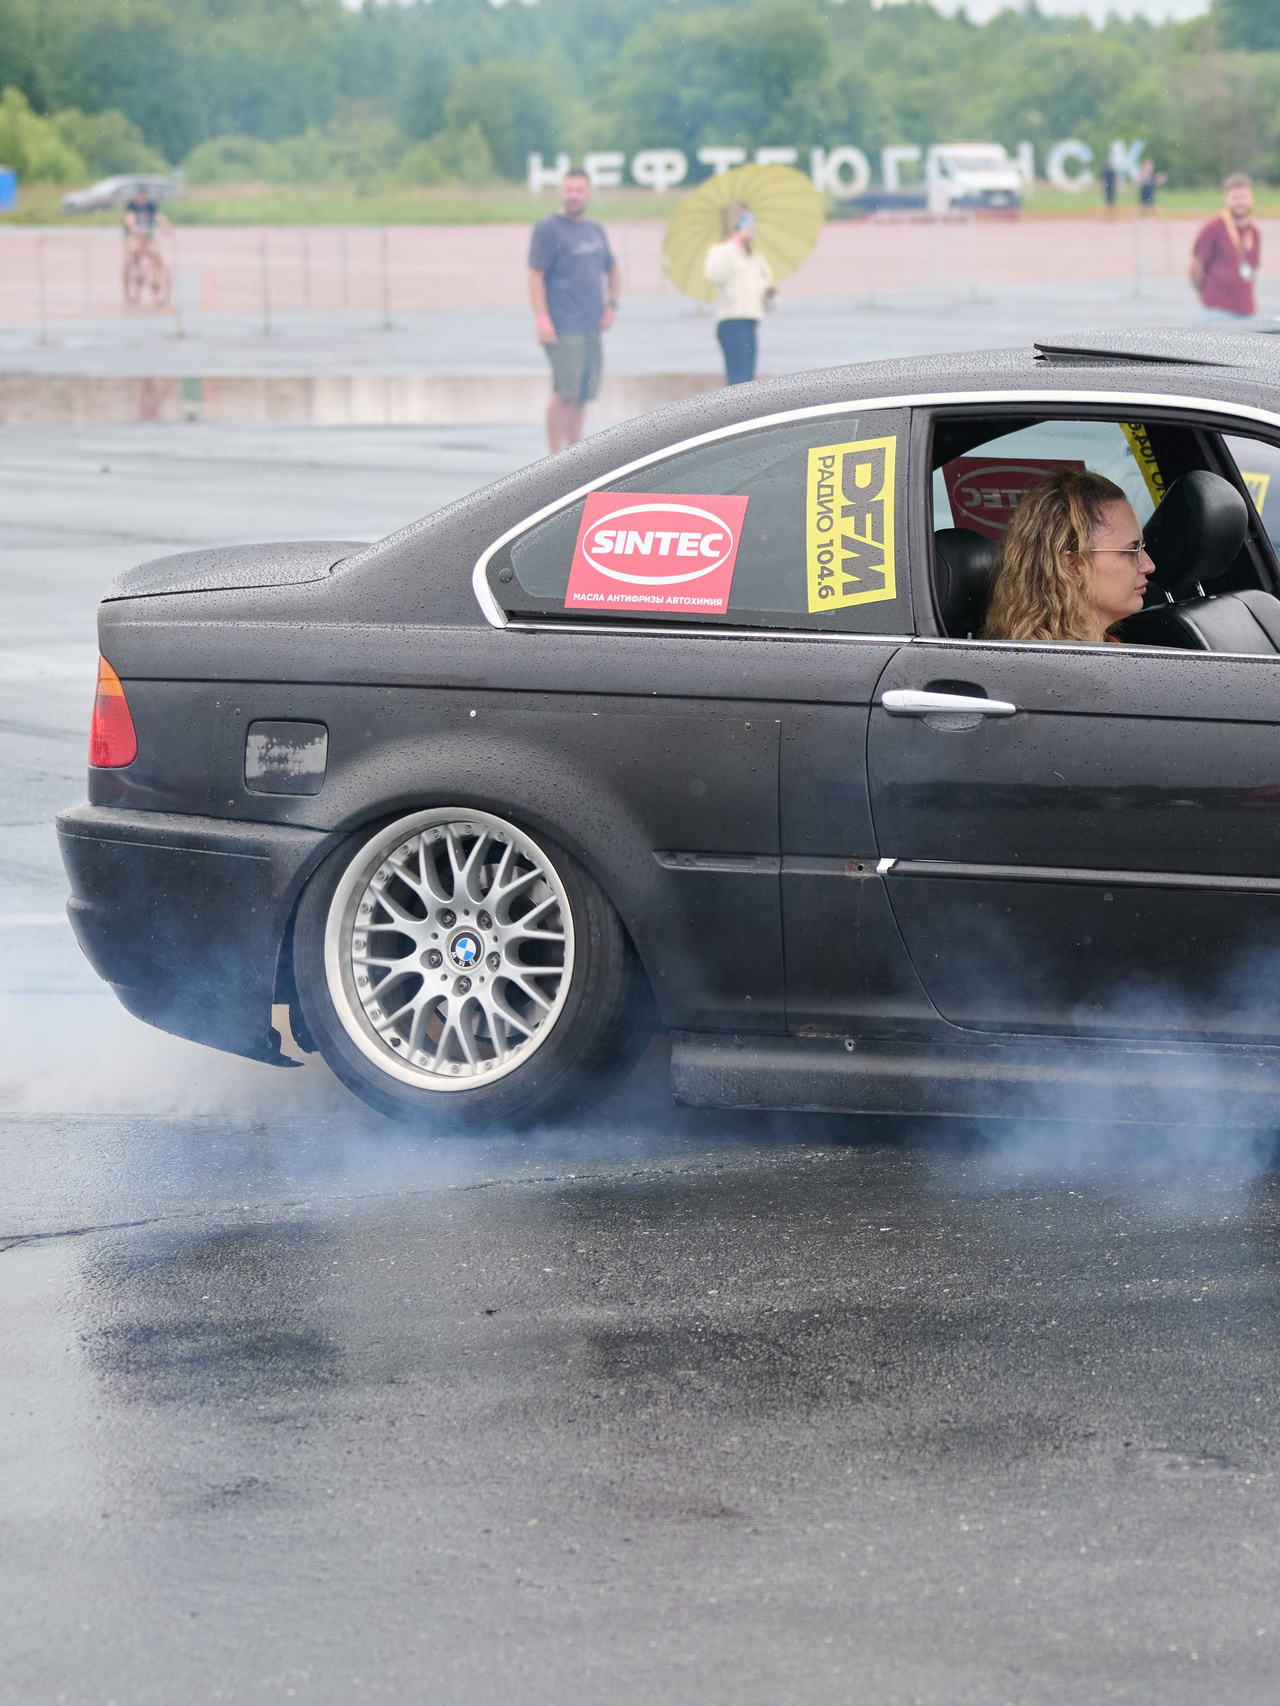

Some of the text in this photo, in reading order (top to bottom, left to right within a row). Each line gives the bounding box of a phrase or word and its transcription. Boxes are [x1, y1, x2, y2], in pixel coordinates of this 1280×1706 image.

[527, 138, 1147, 198] НЕФТЮГНСК
[817, 455, 836, 599] РАДИО 104.6
[841, 447, 886, 596] DFM
[591, 530, 724, 557] SINTEC
[573, 593, 723, 606] МАСЛА АНТИФРИЗЫ АВТОХИМИЯ
[451, 951, 476, 967] BMW
